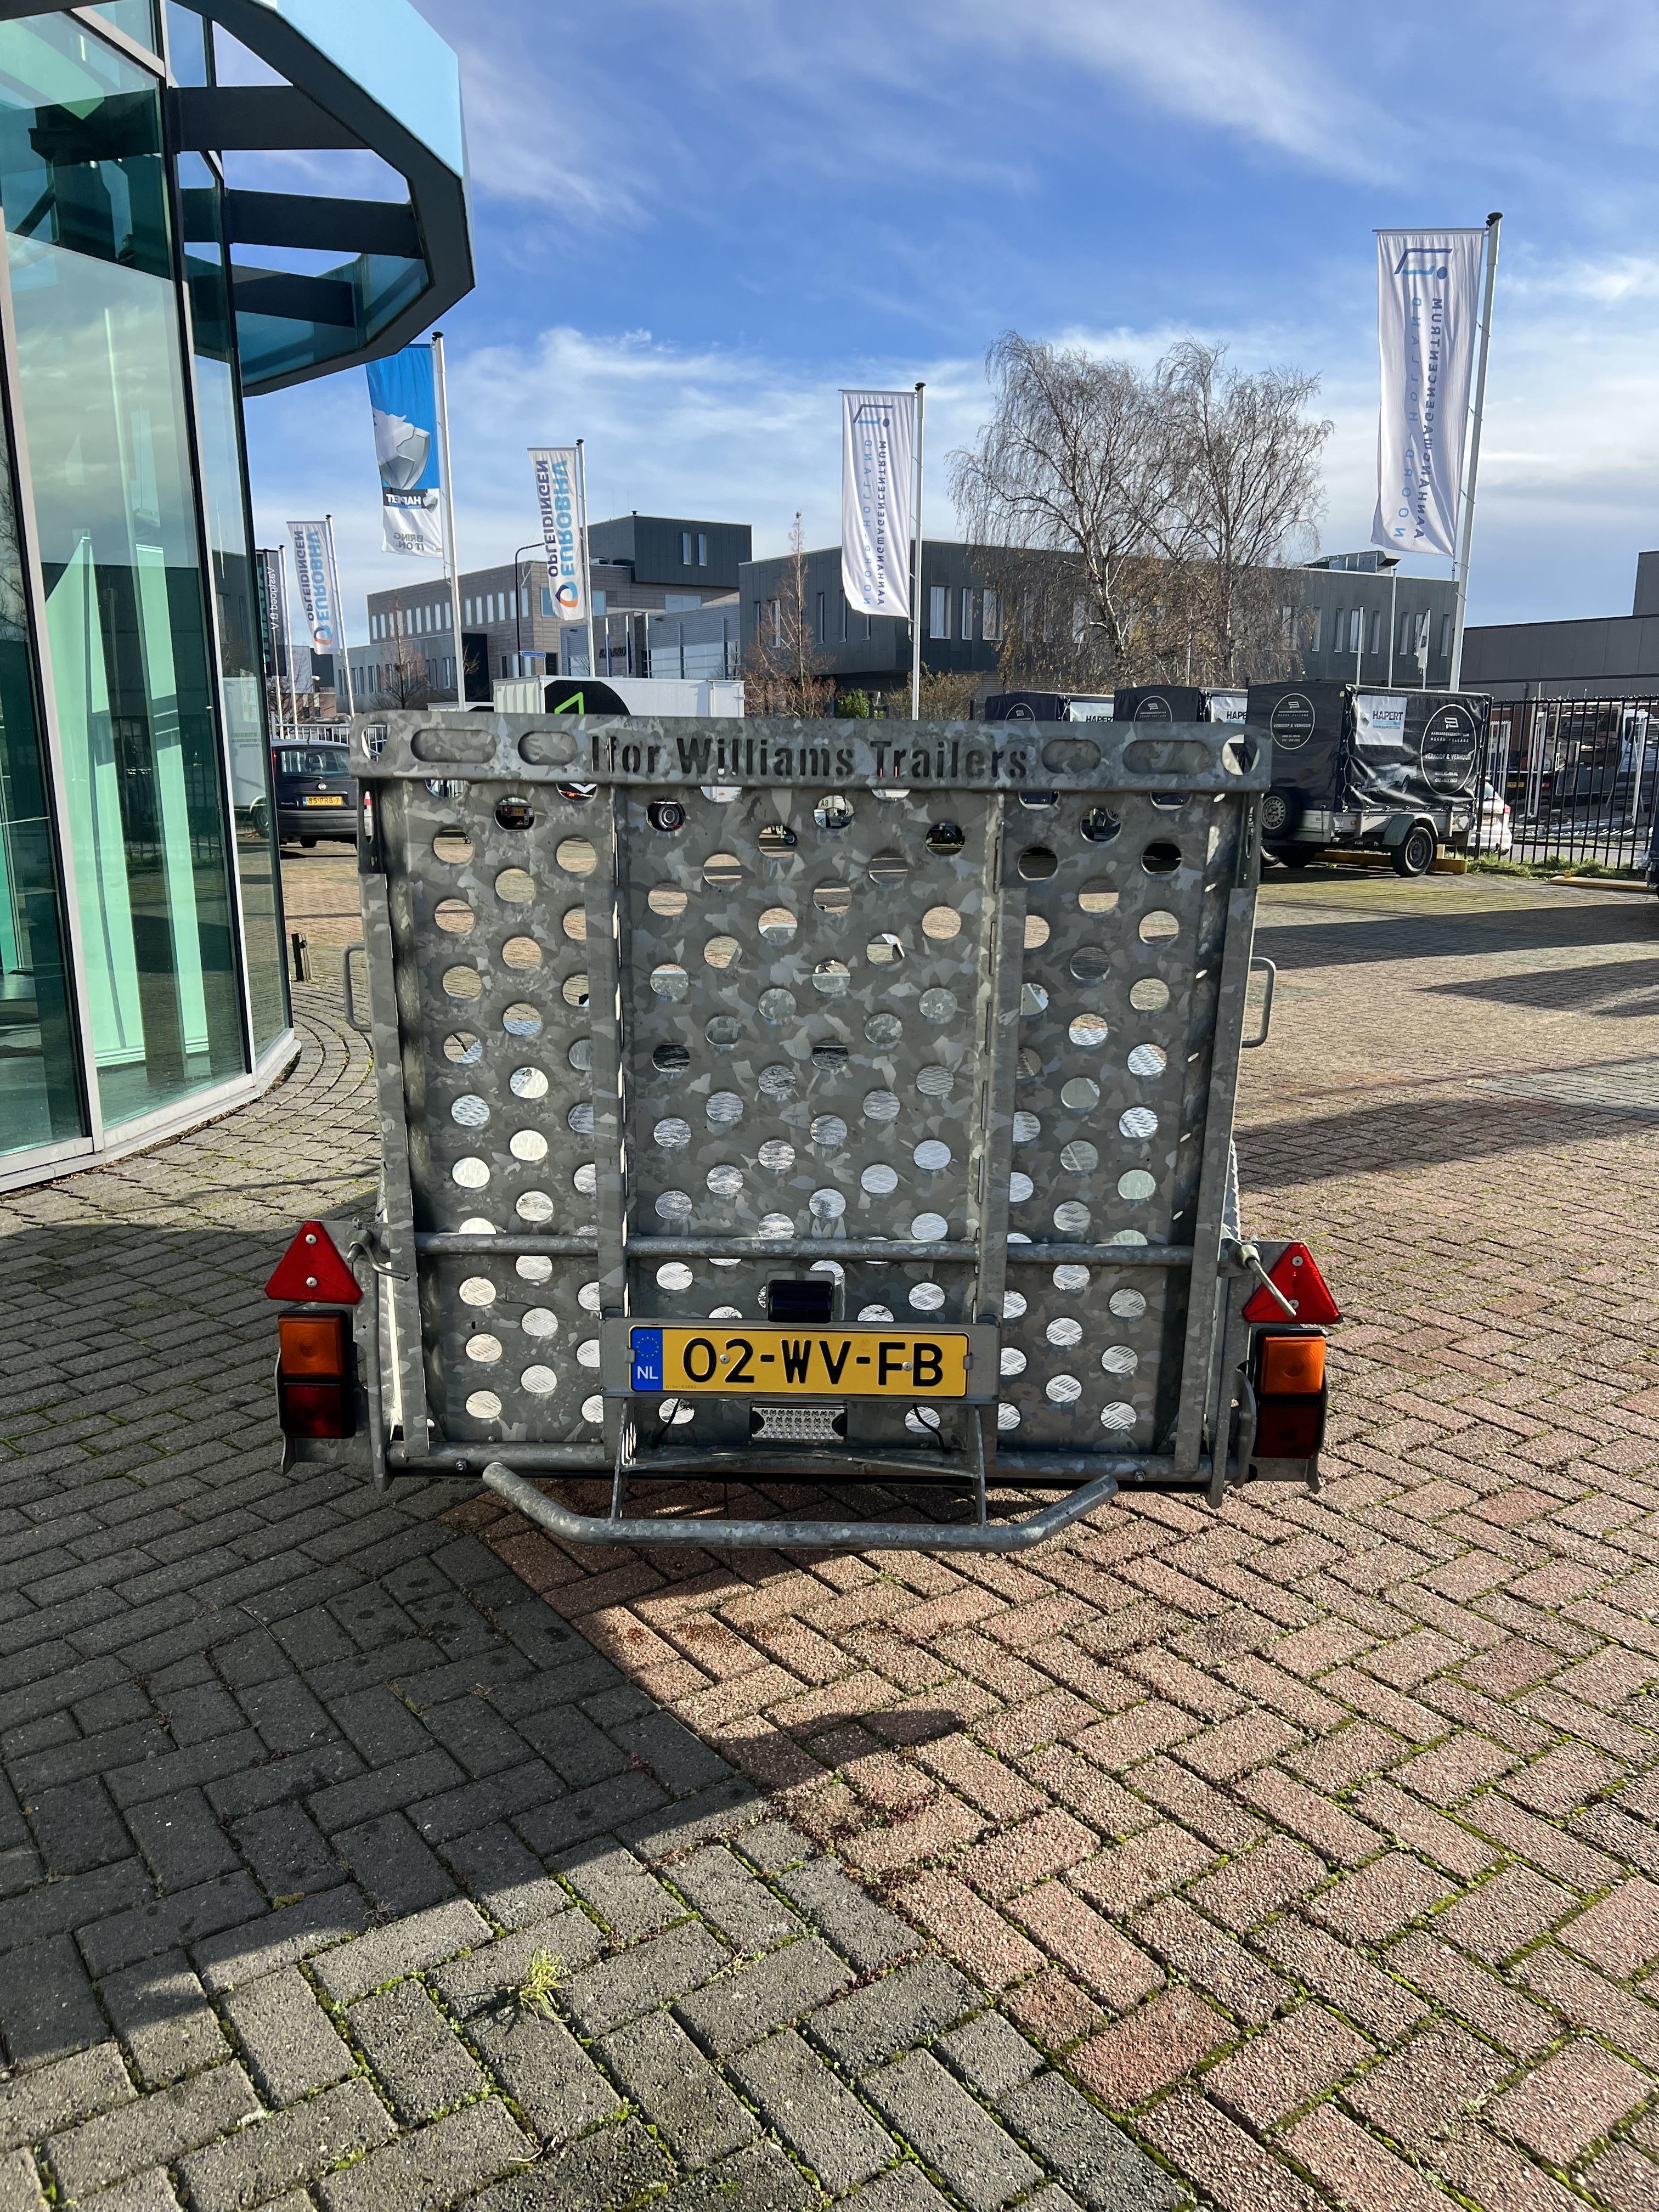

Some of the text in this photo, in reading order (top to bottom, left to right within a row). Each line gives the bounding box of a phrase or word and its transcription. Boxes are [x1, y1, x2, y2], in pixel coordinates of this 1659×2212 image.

[1373, 711, 1403, 720] HAPERT
[591, 736, 1026, 779] Ifor Williams Trailers
[636, 1365, 659, 1380] NL
[682, 1338, 944, 1387] 02-WV-FB
